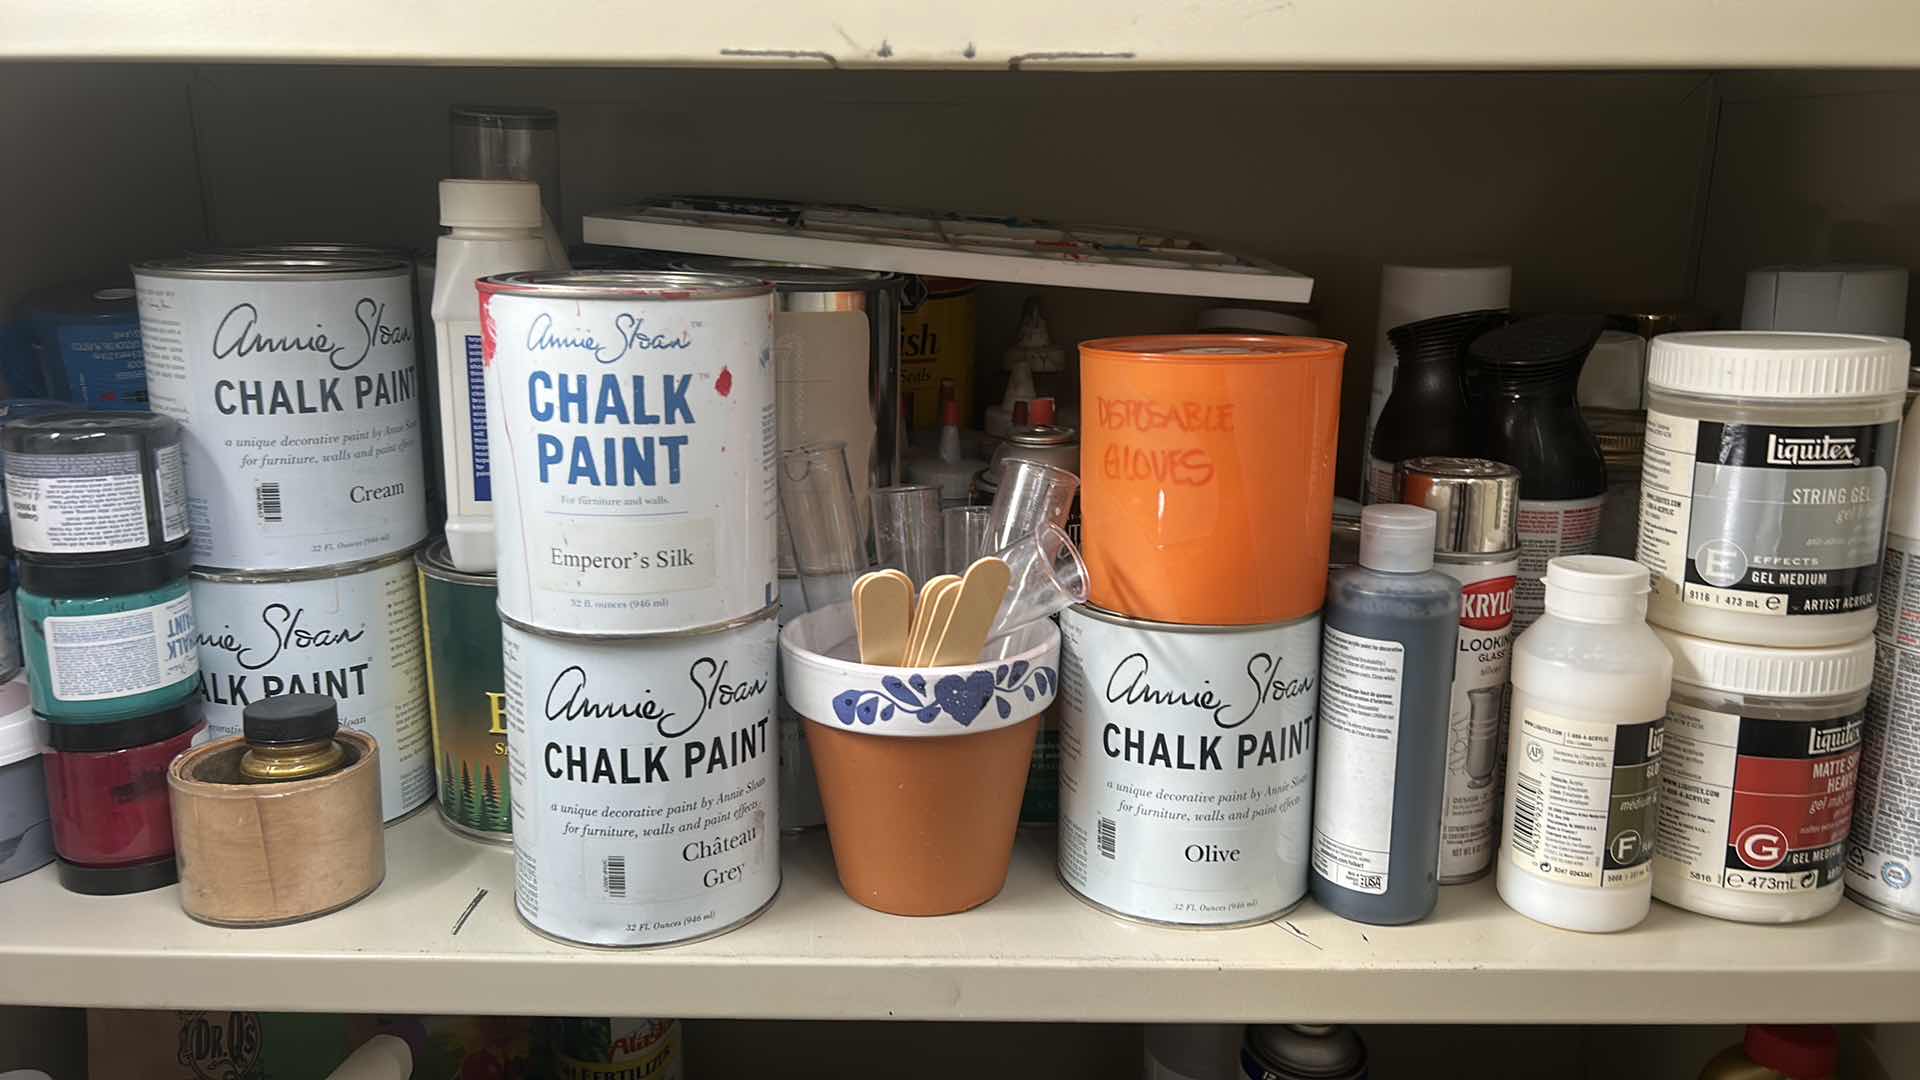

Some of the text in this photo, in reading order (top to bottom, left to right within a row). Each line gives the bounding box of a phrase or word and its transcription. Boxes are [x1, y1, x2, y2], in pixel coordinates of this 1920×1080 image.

[213, 303, 335, 359] Annie
[330, 298, 413, 370] Sloan
[527, 313, 599, 351] Annie
[595, 313, 692, 363] Sloan
[900, 323, 939, 357] ish
[214, 366, 416, 415] CHALK PAINT
[528, 371, 695, 424] CHALK
[236, 436, 276, 449] unique
[280, 432, 340, 447] decorative
[343, 431, 369, 446] paint
[1767, 434, 1856, 465] Liquitex
[240, 454, 257, 469] for
[323, 450, 350, 464] walls
[353, 446, 374, 458] and
[537, 434, 688, 486] PAINT
[1104, 442, 1216, 486] GLOVES
[350, 482, 405, 503] Cream
[561, 496, 575, 504] For
[577, 495, 622, 506] furniture
[625, 496, 643, 505] and
[1792, 486, 1871, 505] STRING GEL
[656, 548, 695, 568] Silk
[1753, 556, 1820, 566] EFFECTS
[1751, 571, 1828, 585] GEL MEDIUM
[1461, 590, 1513, 618] KRYLO
[1690, 590, 1760, 608] 9116 473 mL
[1804, 598, 1840, 611] ARTIST
[236, 603, 365, 670] Sloan
[199, 671, 251, 705] ALK
[545, 666, 663, 721] Annie
[657, 656, 768, 738] Sloan
[1106, 653, 1221, 709] Annie
[1214, 652, 1313, 729] Sloan
[544, 717, 768, 784] CHALK PAINT
[1103, 716, 1313, 770] CHALK PAINT
[1813, 759, 1845, 779] MATTE
[560, 804, 598, 819] unique
[601, 805, 663, 818] decorative
[666, 801, 698, 817] paint
[700, 795, 714, 809] by
[716, 788, 745, 804] Annie
[1106, 780, 1113, 789] a
[1116, 782, 1153, 800] unique
[1156, 788, 1215, 802] decorative
[1217, 788, 1247, 805] paint
[1250, 787, 1261, 801] by
[1117, 800, 1133, 812] for
[1194, 809, 1225, 821] walls
[1228, 805, 1249, 820] and
[1251, 803, 1278, 819] paint
[562, 821, 579, 835] for
[580, 824, 638, 838] furniture,
[643, 823, 675, 836] walls
[678, 817, 701, 833] and
[703, 812, 731, 829] paint
[682, 828, 757, 862] Château
[1185, 844, 1241, 863] Olive
[1618, 835, 1637, 861] F
[1744, 833, 1780, 861] G
[1792, 852, 1809, 864] GEL
[703, 864, 745, 888] Grey
[625, 924, 637, 932] 32
